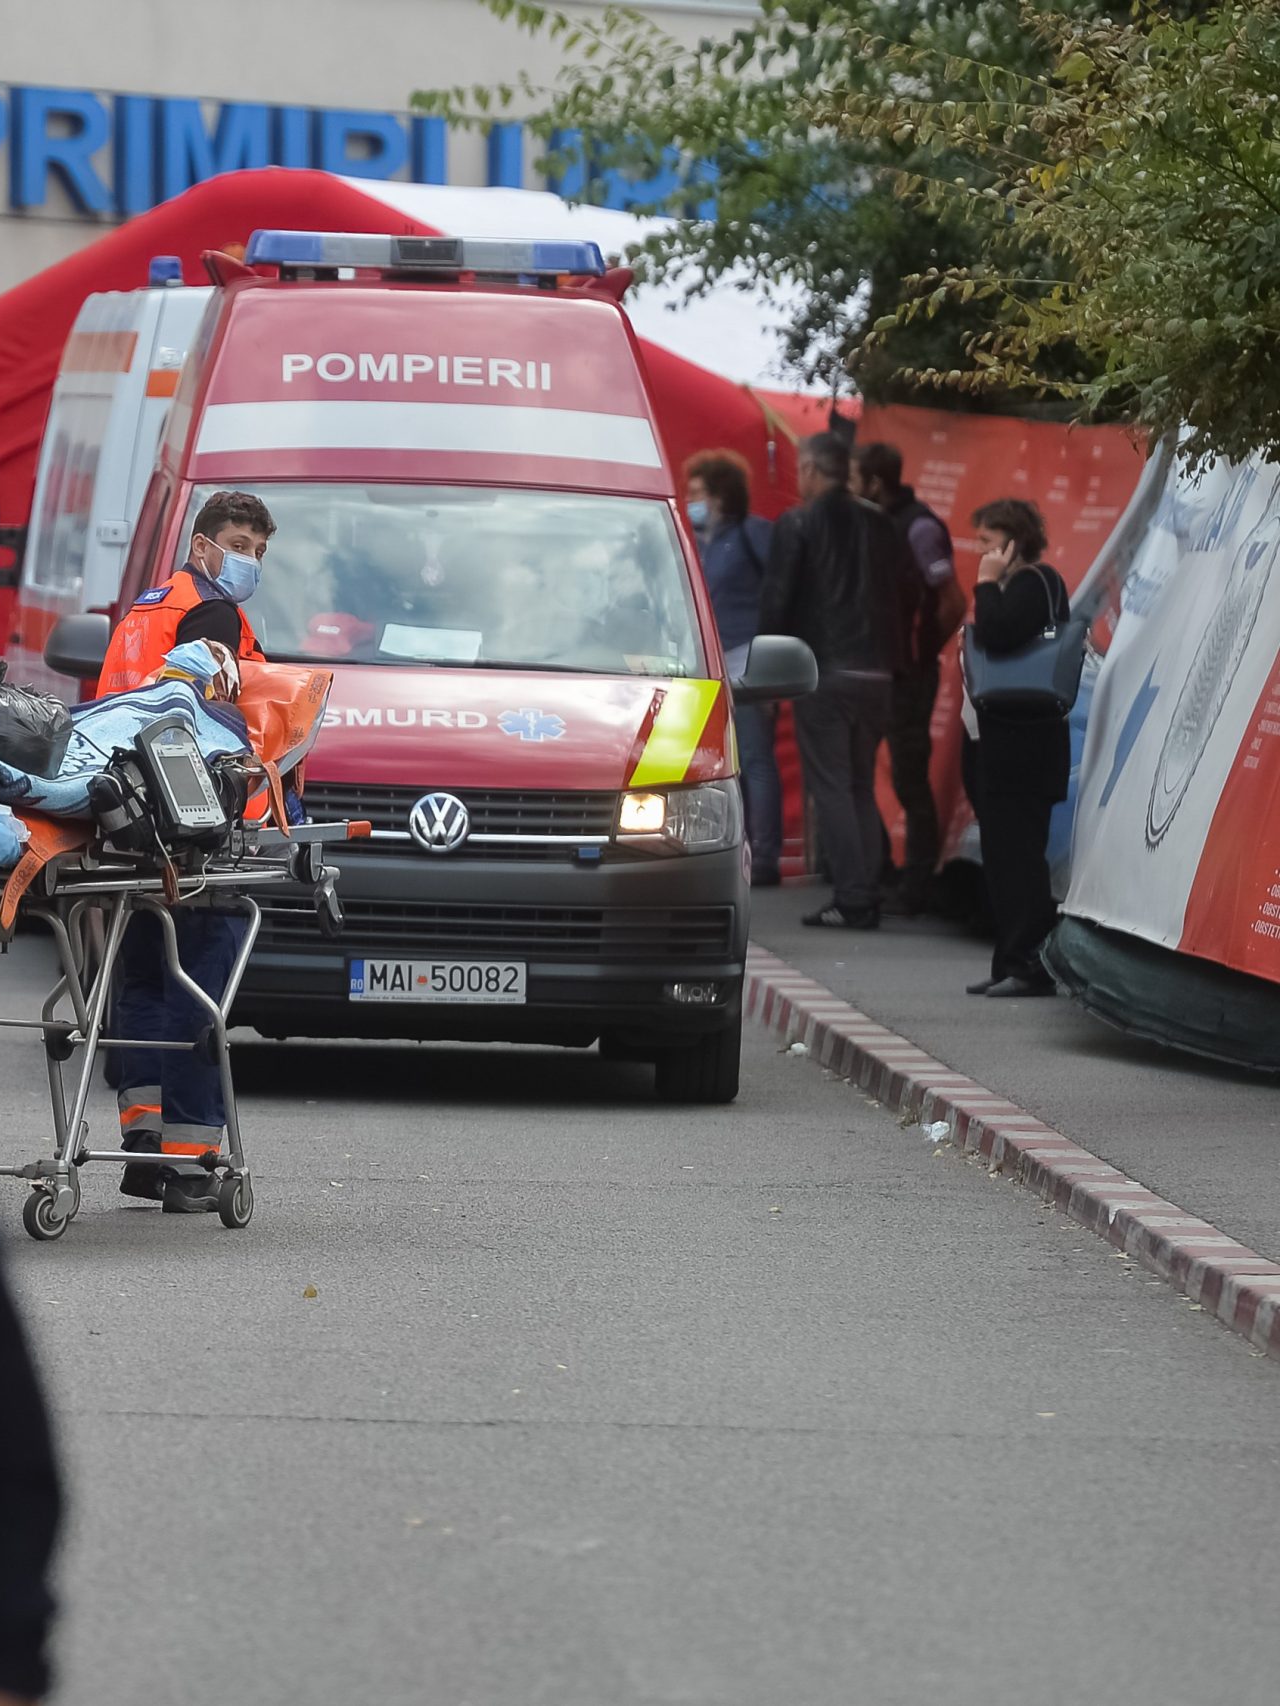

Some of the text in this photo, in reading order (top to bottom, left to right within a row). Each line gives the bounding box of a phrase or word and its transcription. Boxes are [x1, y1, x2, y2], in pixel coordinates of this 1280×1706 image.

[281, 352, 552, 391] POMPIERII
[322, 708, 488, 728] SMURD
[370, 964, 412, 991] MAI
[431, 965, 518, 993] 50082
